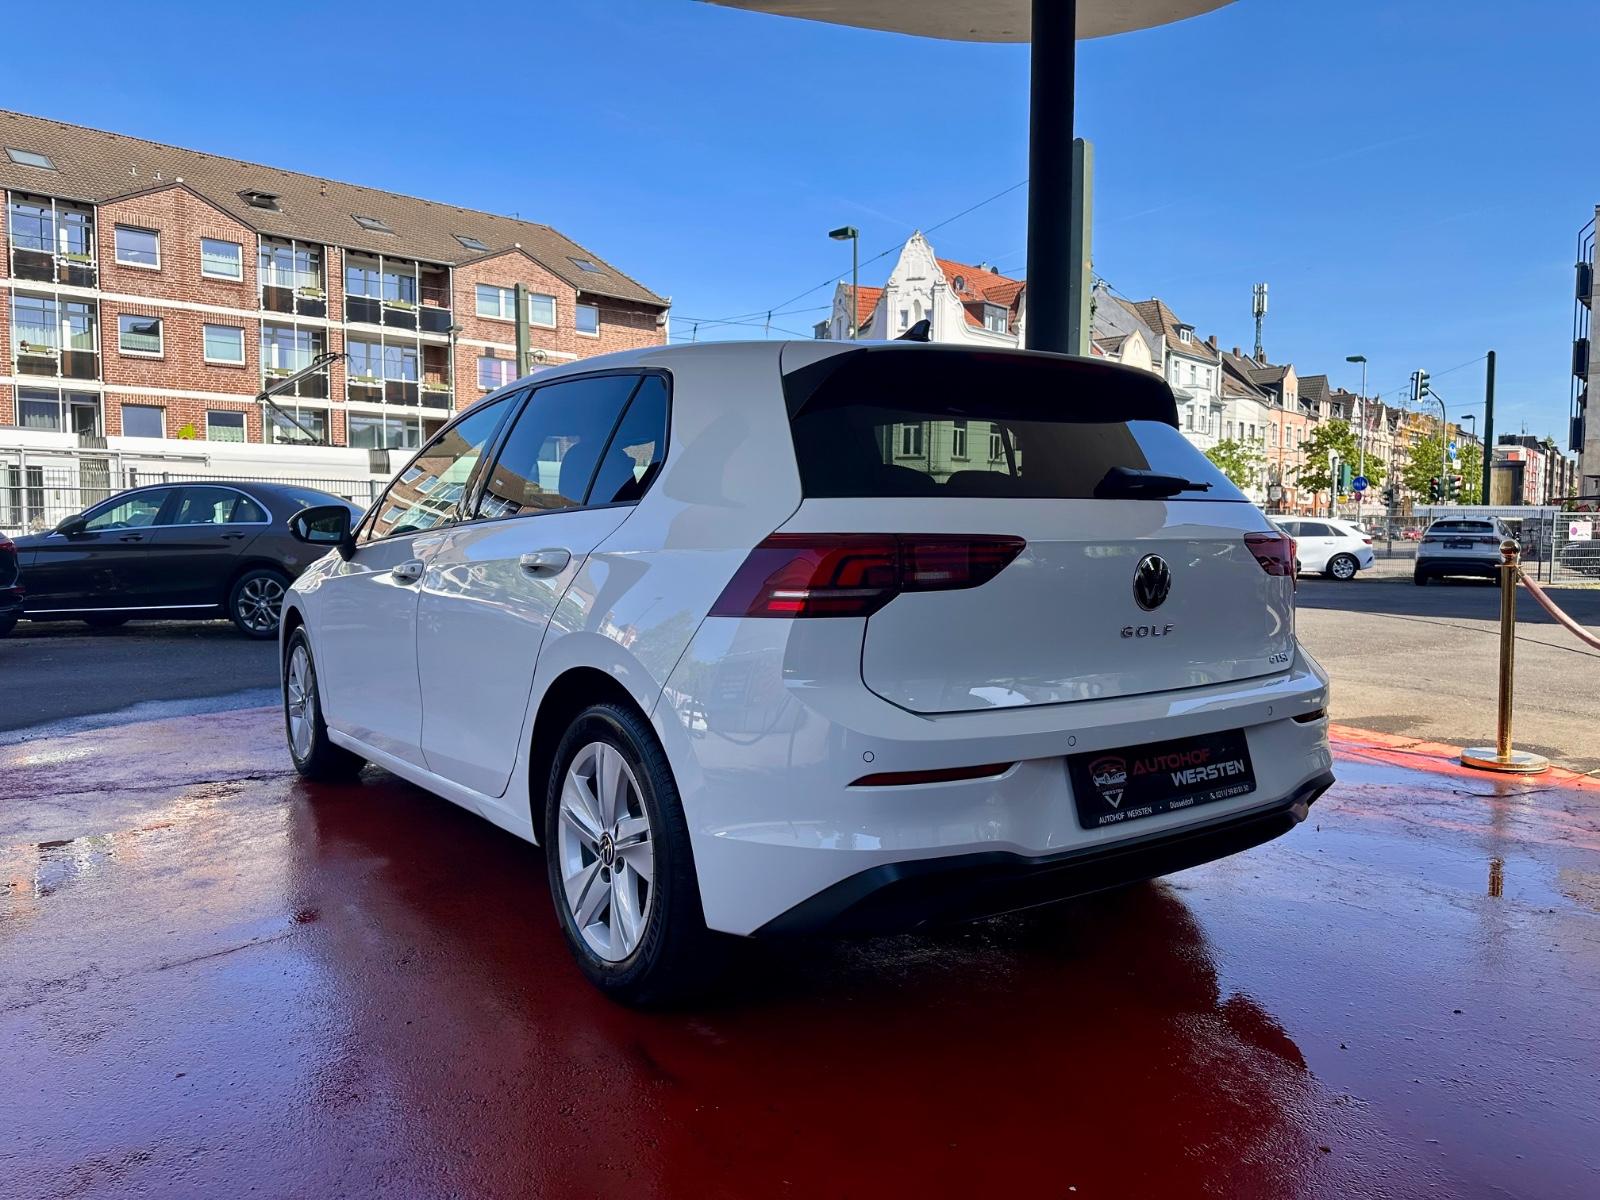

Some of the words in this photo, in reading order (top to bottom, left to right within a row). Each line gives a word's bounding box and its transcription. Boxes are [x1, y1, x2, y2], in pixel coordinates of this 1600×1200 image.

[1120, 623, 1175, 639] GOLF
[1132, 748, 1211, 776] AUTOHOF
[1171, 759, 1245, 787] WERSTEN
[1098, 813, 1125, 825] AUTOHOF
[1126, 806, 1152, 819] WERSTEN
[1169, 796, 1194, 809] Düsseldorf
